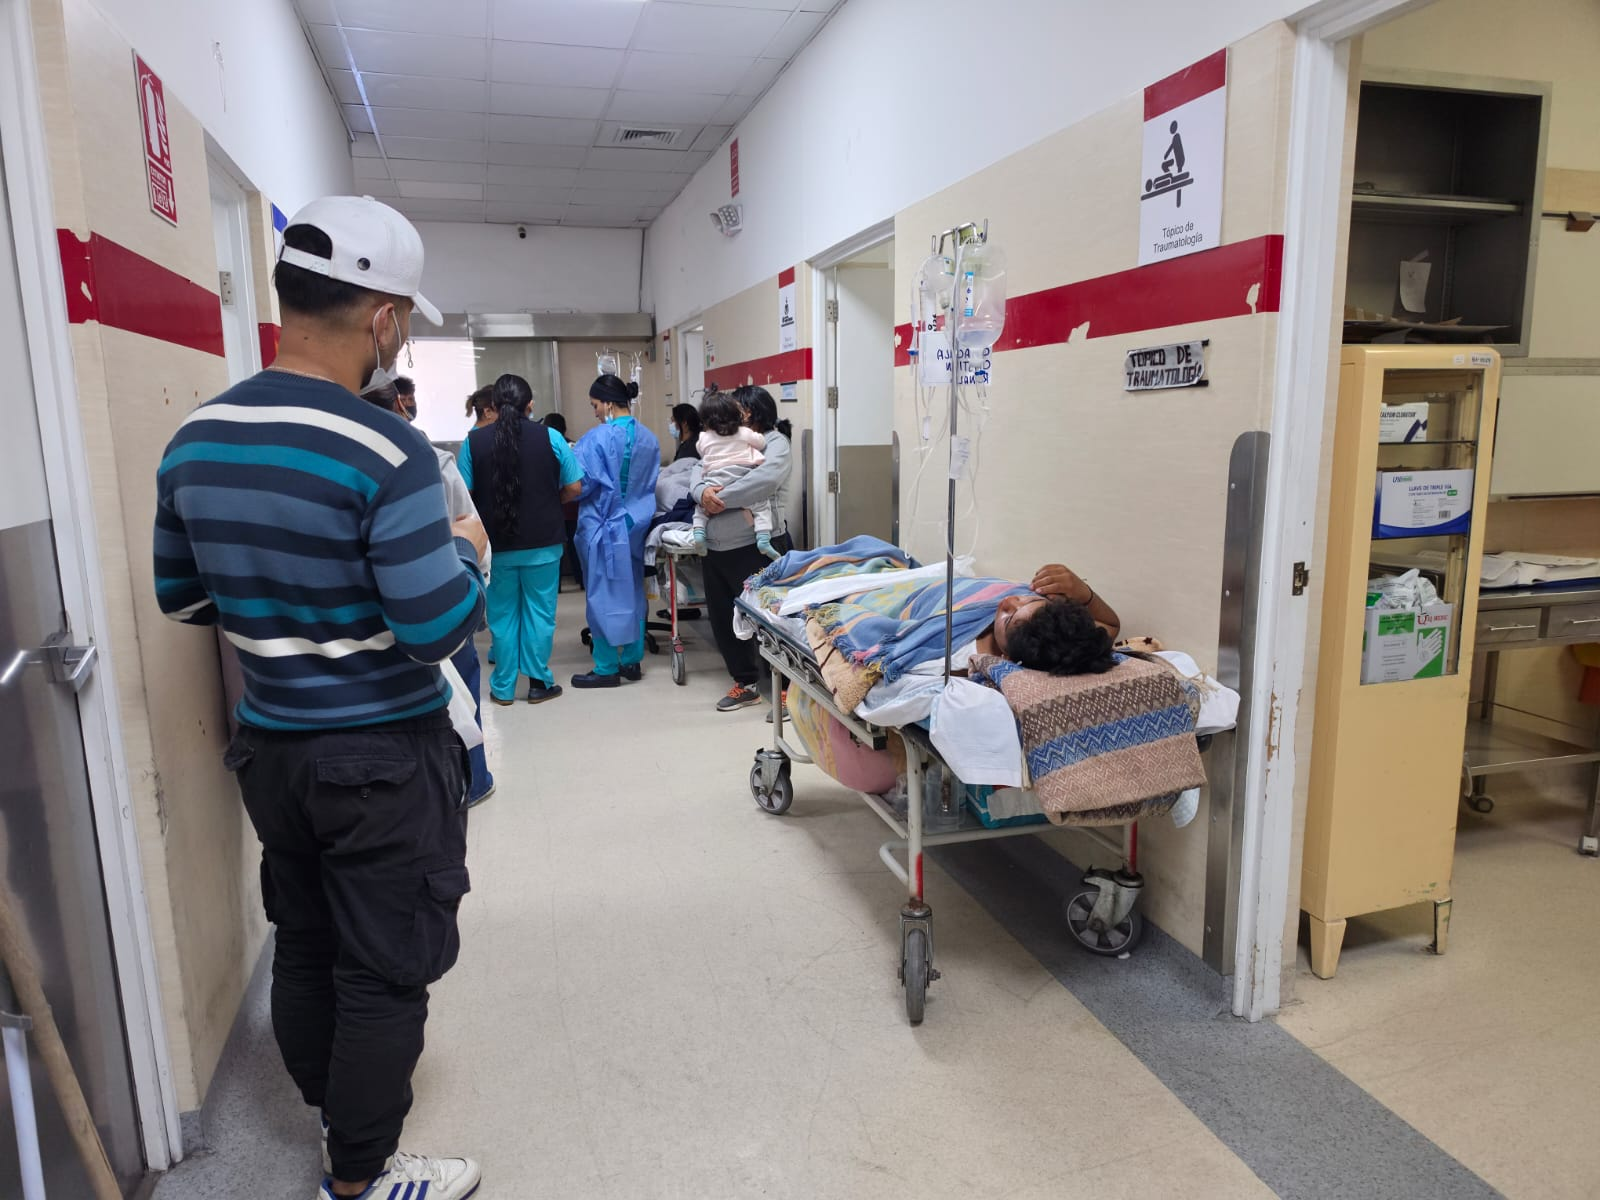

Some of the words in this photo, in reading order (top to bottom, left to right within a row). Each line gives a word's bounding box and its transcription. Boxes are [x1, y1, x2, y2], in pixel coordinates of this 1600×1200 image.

[1162, 224, 1184, 239] Tópico
[1185, 221, 1194, 232] de
[1153, 232, 1203, 254] Traumatología
[1129, 349, 1166, 369] TOPICO
[1176, 344, 1193, 365] DE
